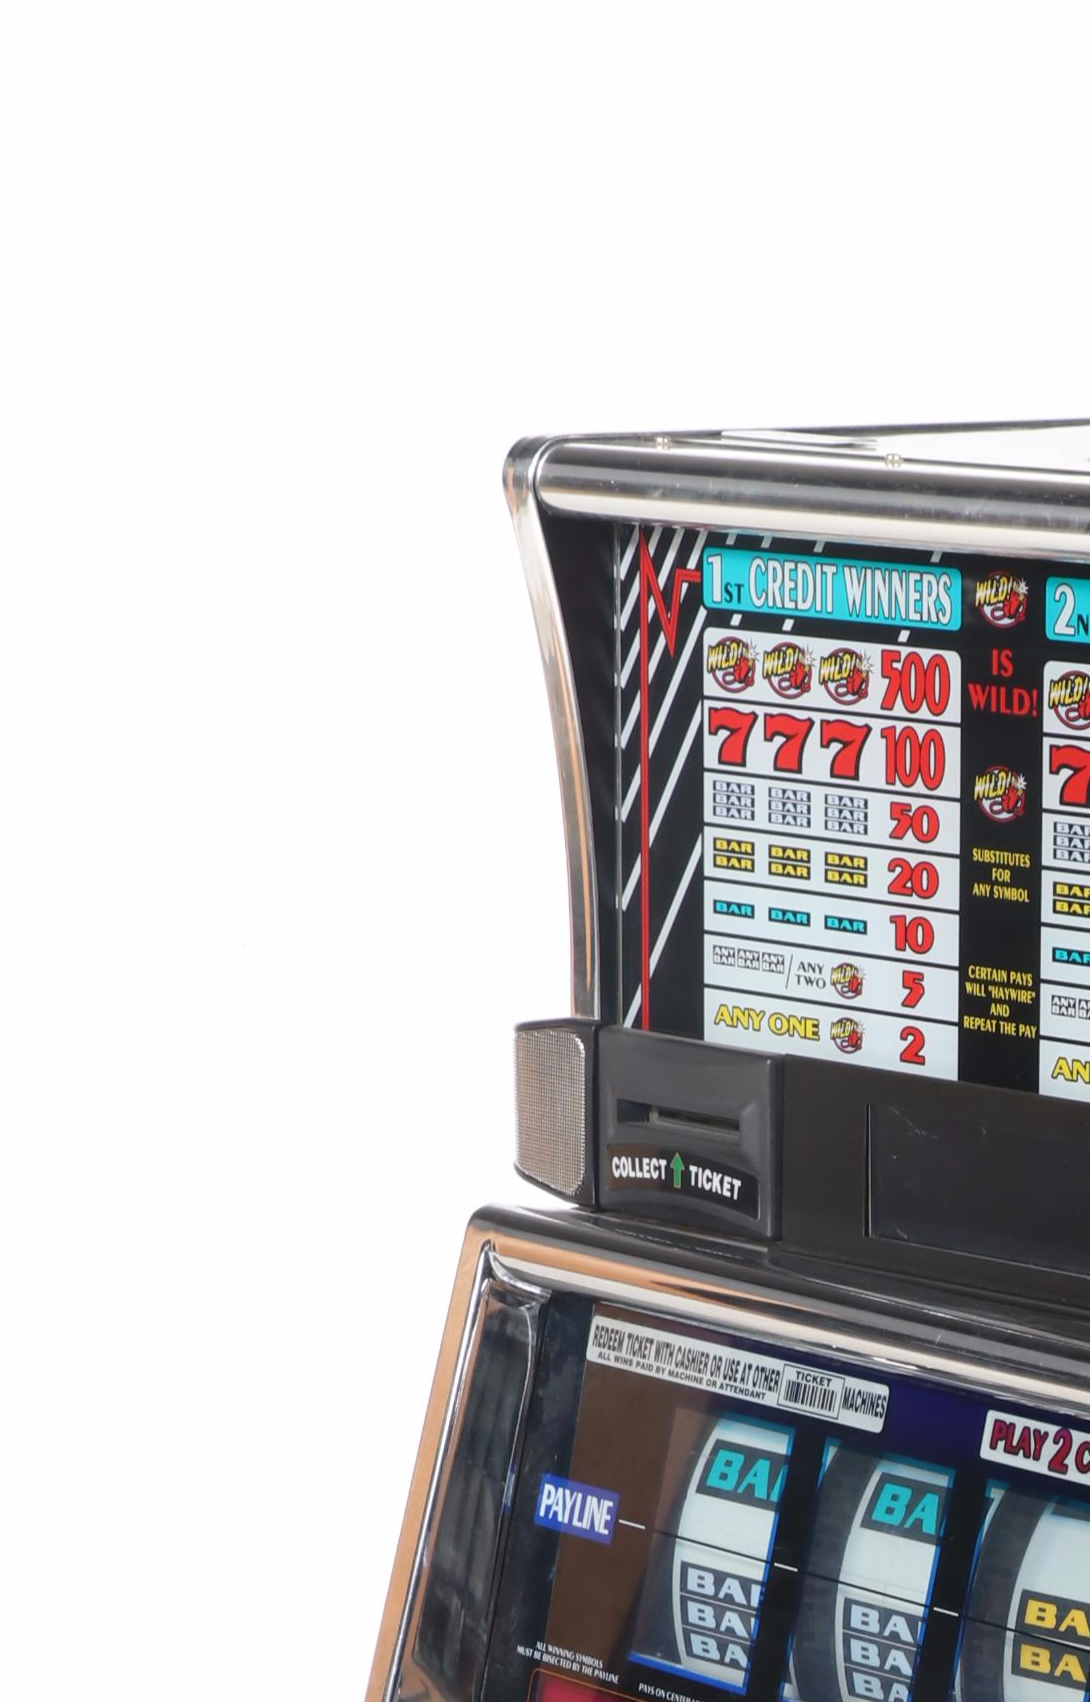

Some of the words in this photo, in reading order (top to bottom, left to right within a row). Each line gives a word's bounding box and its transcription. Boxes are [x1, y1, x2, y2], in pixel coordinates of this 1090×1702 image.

[707, 554, 744, 604] 1ST
[749, 558, 837, 614] CREDIT
[843, 567, 952, 625] WINNERS
[975, 575, 1013, 606] WILD!
[707, 640, 743, 672] WILD!
[762, 646, 801, 678] WILD!
[819, 652, 858, 684] WILD!
[880, 650, 950, 715] 500
[991, 649, 1014, 678] IS
[967, 683, 1038, 716] WILD!
[1049, 676, 1088, 708] WILD!
[709, 707, 757, 766] 7
[764, 713, 814, 774] 7
[820, 719, 871, 780] 7
[881, 726, 945, 790] 100
[974, 771, 1012, 801] WILD!
[889, 803, 939, 843] 50
[715, 838, 752, 853] BAR
[771, 845, 808, 861] BAR
[827, 853, 865, 869] BAR
[887, 858, 939, 899] 20
[715, 855, 752, 870] BAR
[771, 863, 809, 879] BAR
[827, 871, 866, 886] BAR
[972, 848, 1031, 867] SUBSTITUTES
[992, 868, 1011, 883] FOR
[973, 884, 991, 898] ANY
[993, 886, 1030, 903] SYMBOL
[715, 902, 753, 917] BAR
[771, 910, 808, 925] BAR
[827, 918, 865, 933] BAR
[890, 915, 934, 954] 10
[795, 974, 826, 989] TWO
[797, 961, 824, 975] ANY
[830, 966, 855, 985] WILD!
[901, 971, 925, 1008] 5
[968, 965, 1004, 983] CERTAIN
[1006, 970, 1033, 986] PAYS
[965, 982, 986, 998] WILL
[988, 985, 1036, 1004] "HAYWIRE"
[990, 1003, 1010, 1017] AND
[714, 1005, 765, 1031] ANY
[768, 1012, 820, 1040] ONE
[830, 1020, 855, 1040] WILD!
[900, 1026, 925, 1065] 2
[963, 1016, 997, 1034] REPEAT
[999, 1020, 1016, 1036] THE
[1017, 1022, 1037, 1039] PAY
[612, 1156, 667, 1180] COLLECT
[689, 1165, 742, 1200] TICKET
[592, 1325, 625, 1351] REDEEM
[626, 1333, 654, 1359] TICKET
[654, 1340, 674, 1364] WITH
[674, 1345, 709, 1374] CASHIER
[710, 1355, 722, 1376] OR
[722, 1357, 739, 1381] USE
[739, 1362, 752, 1383] AT
[752, 1365, 781, 1392] OTHER
[795, 1370, 832, 1388] TICKET
[841, 1385, 888, 1419] MACHINES
[597, 1352, 612, 1361] ALL
[613, 1354, 634, 1367] WINS
[635, 1360, 654, 1372] PAID
[655, 1365, 666, 1375] BY
[667, 1368, 705, 1385] MACHINE
[705, 1377, 717, 1388] OR
[718, 1381, 766, 1400] ATTENDANT
[990, 1419, 1049, 1461] PLAY
[1048, 1427, 1073, 1474] 2
[539, 1483, 613, 1535] PAYLINE
[638, 1683, 655, 1696] PAYS
[655, 1688, 665, 1699] ON
